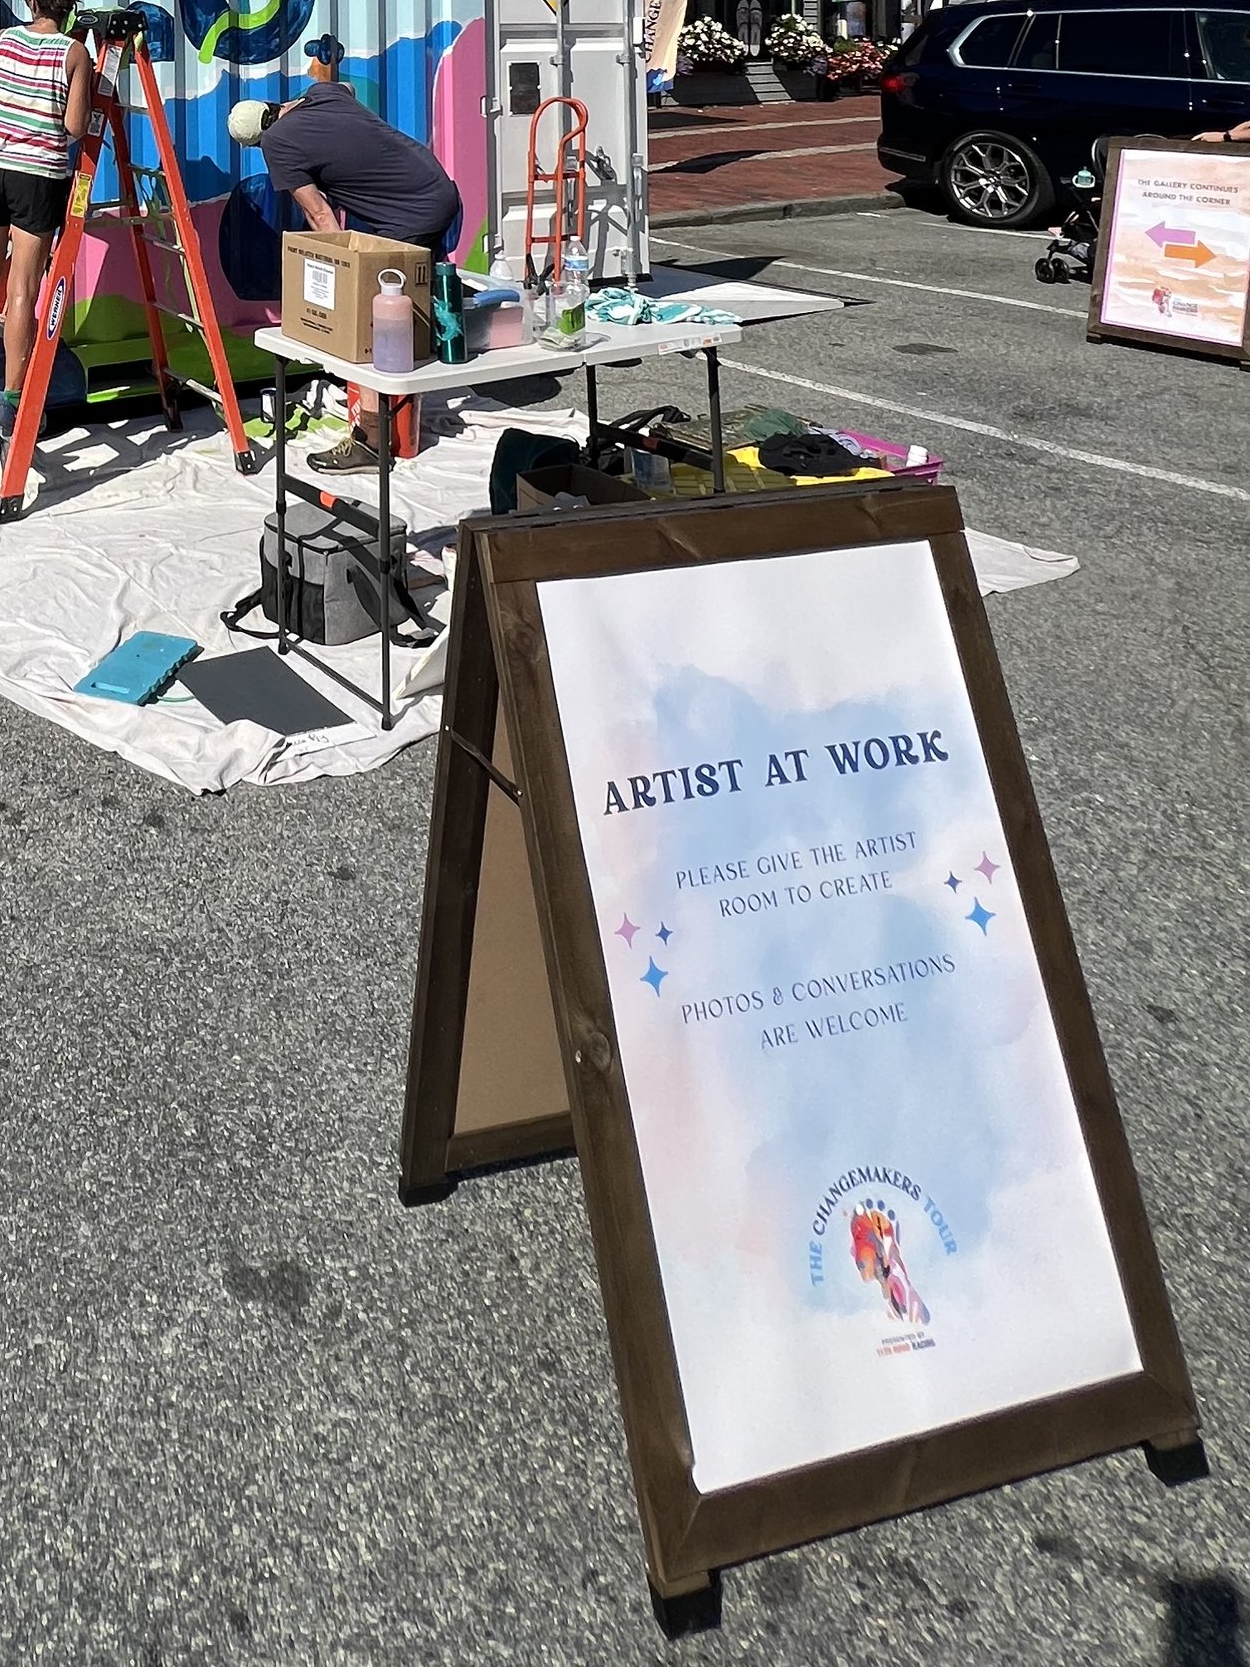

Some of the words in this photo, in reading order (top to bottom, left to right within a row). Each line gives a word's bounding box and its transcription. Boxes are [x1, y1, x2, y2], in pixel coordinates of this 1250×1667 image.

[1142, 191, 1177, 200] AROUND
[1179, 194, 1194, 202] THE
[1196, 196, 1231, 205] CORNER
[1154, 180, 1187, 189] GALLERY
[1190, 183, 1239, 194] CONTINUES
[603, 758, 744, 816] ARTIST
[765, 748, 810, 787] AT
[824, 729, 950, 775] WORK
[676, 860, 750, 889] PLEASE
[757, 851, 803, 875] GIVE
[809, 844, 846, 866] THE
[855, 831, 917, 860] ARTIST
[719, 890, 778, 917] ROOM
[784, 885, 812, 906] TO
[819, 870, 893, 899] CREATE
[681, 991, 764, 1024] PHOTOS
[772, 986, 785, 1006] &
[791, 954, 956, 1002] CONVERSATIONS
[760, 1024, 799, 1050] ARE
[805, 1003, 908, 1039] WELCOME
[813, 1166, 922, 1236] CHANGEMAKERS
[923, 1195, 958, 1256] TOUR
[809, 1240, 824, 1288] THE
